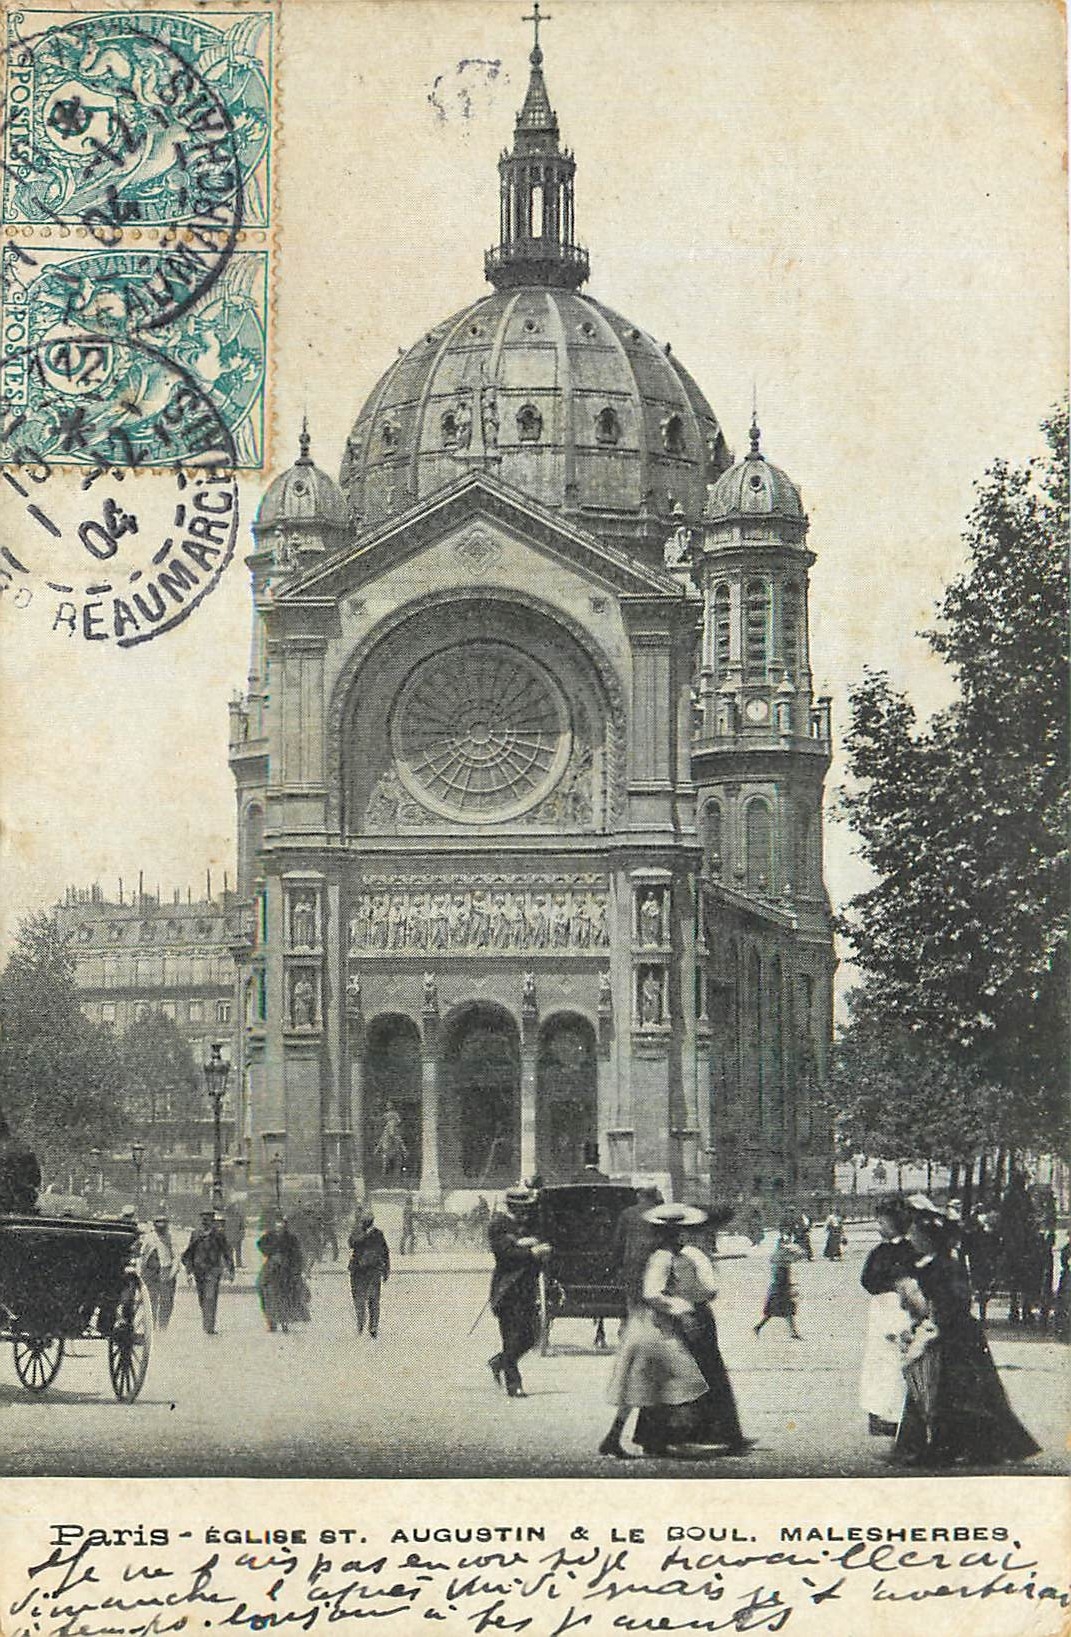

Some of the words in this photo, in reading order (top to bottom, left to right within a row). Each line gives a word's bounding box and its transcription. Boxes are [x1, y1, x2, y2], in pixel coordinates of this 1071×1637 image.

[9, 70, 32, 163] POSTES
[5, 306, 27, 406] POSTES
[79, 499, 138, 560] 04
[123, 1564, 174, 1582] ne
[308, 1553, 387, 1586] pas
[398, 1552, 529, 1569] encore
[583, 1572, 724, 1600] mais
